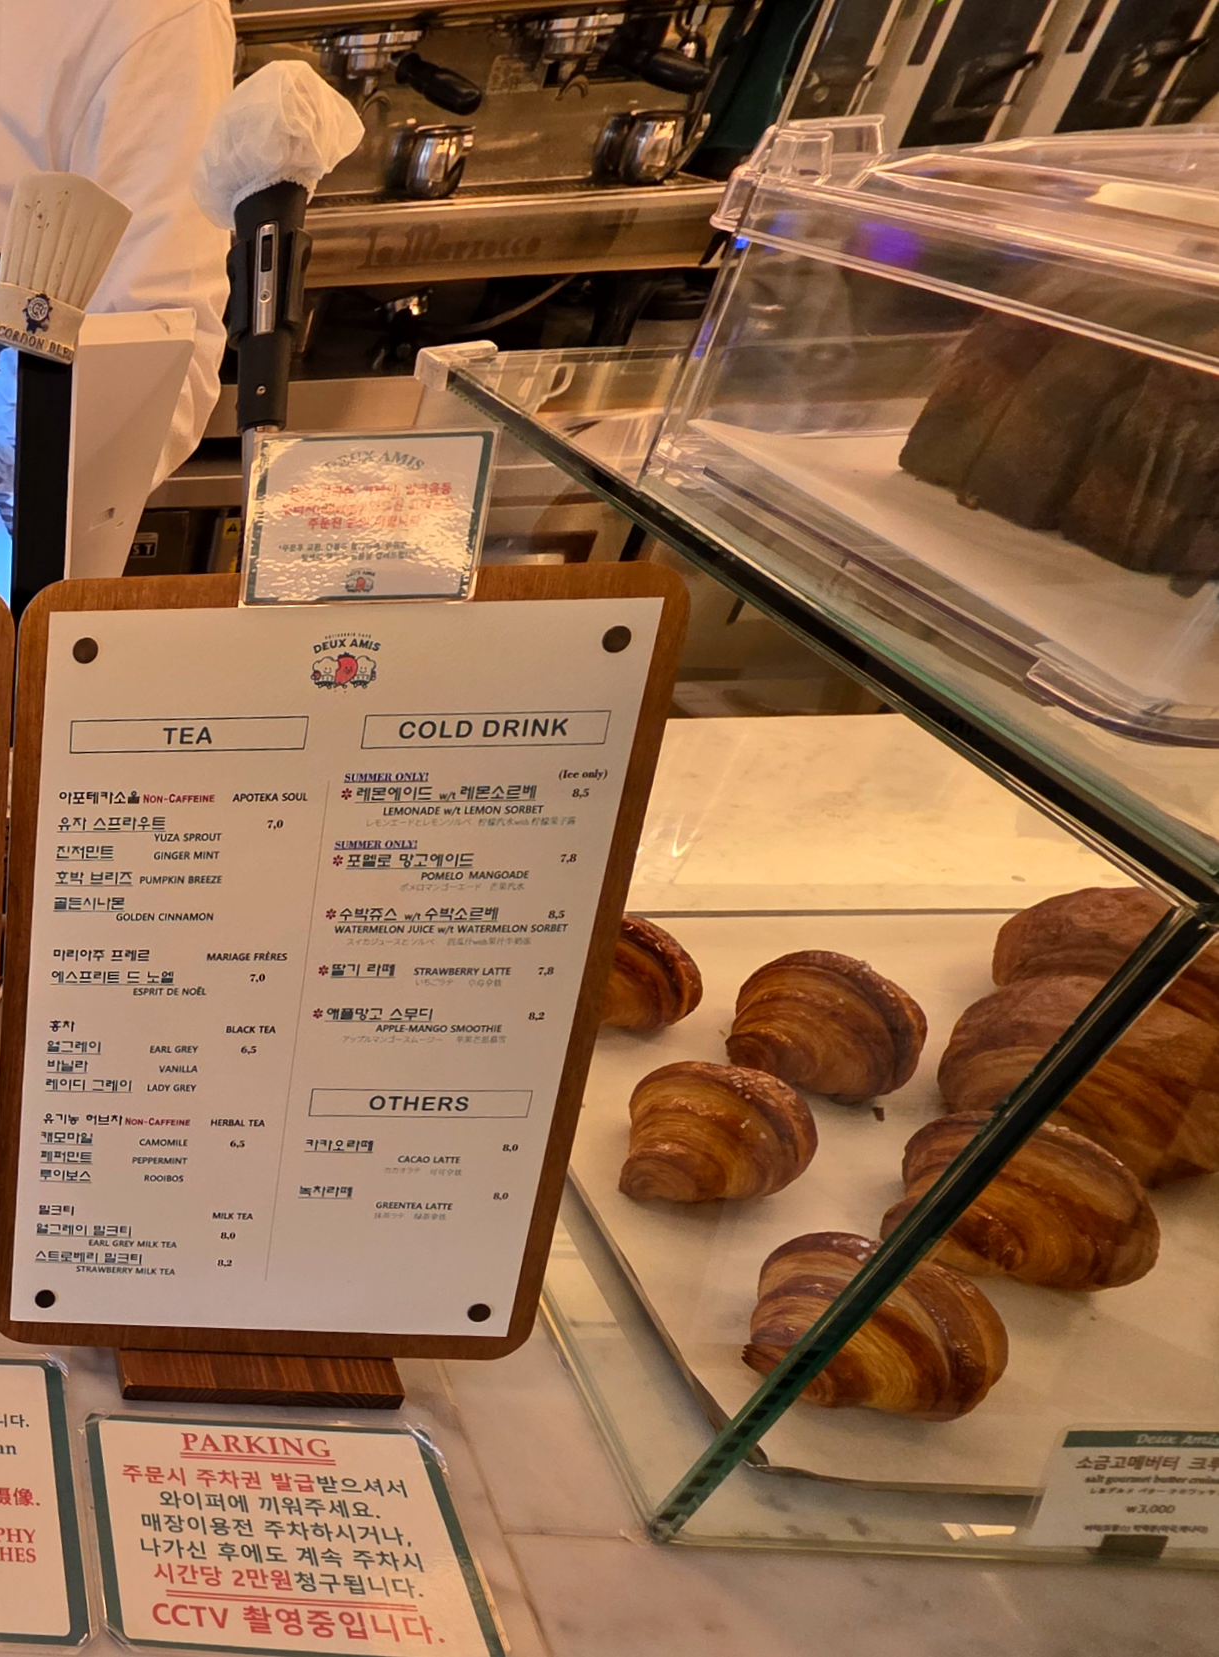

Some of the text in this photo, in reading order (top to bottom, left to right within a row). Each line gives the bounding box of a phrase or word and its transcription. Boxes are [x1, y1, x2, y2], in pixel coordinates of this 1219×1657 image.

[380, 450, 424, 471] AMIS
[313, 638, 380, 653] DEUX AMIS
[399, 718, 569, 739] COLD DRINK
[163, 727, 212, 745] TEA
[58, 817, 166, 831] 유자 스프라우트
[153, 851, 220, 860] GINGER MINT
[139, 875, 222, 885] PUMPKIN BREEZE
[421, 871, 529, 881] POMELO MANGOADE
[116, 912, 213, 921] GOLDEN CINNAMON
[127, 973, 139, 983] 드
[226, 1025, 275, 1034] BLACK TEA
[150, 1045, 198, 1054] EARL GREY
[159, 1065, 197, 1074] VANILLA
[147, 1084, 196, 1093] LADY GREY
[369, 1095, 470, 1112] OTHERS
[211, 1118, 265, 1127] HERBAL TEA
[139, 1138, 188, 1147] CAMOMILE
[398, 1156, 461, 1164] CACAO LATTE
[376, 1202, 453, 1211] GREENTEA LATTE
[212, 1212, 253, 1220] MILK TEA
[181, 1432, 331, 1458] PARKING
[1136, 1433, 1178, 1445] Deux
[1075, 1455, 1180, 1471] 소금고메버터
[122, 1465, 408, 1498] 주문시 주차권 발급받으셔서
[159, 1491, 380, 1520] 와이퍼에 끼워주세요.
[142, 1513, 412, 1548] 매장이용전 주차하시거나,
[140, 1538, 425, 1573] 나가신 후에도 계속 주차시
[154, 1563, 223, 1587] 시간당
[152, 1603, 445, 1645] CCTV 촬영중입니다.
